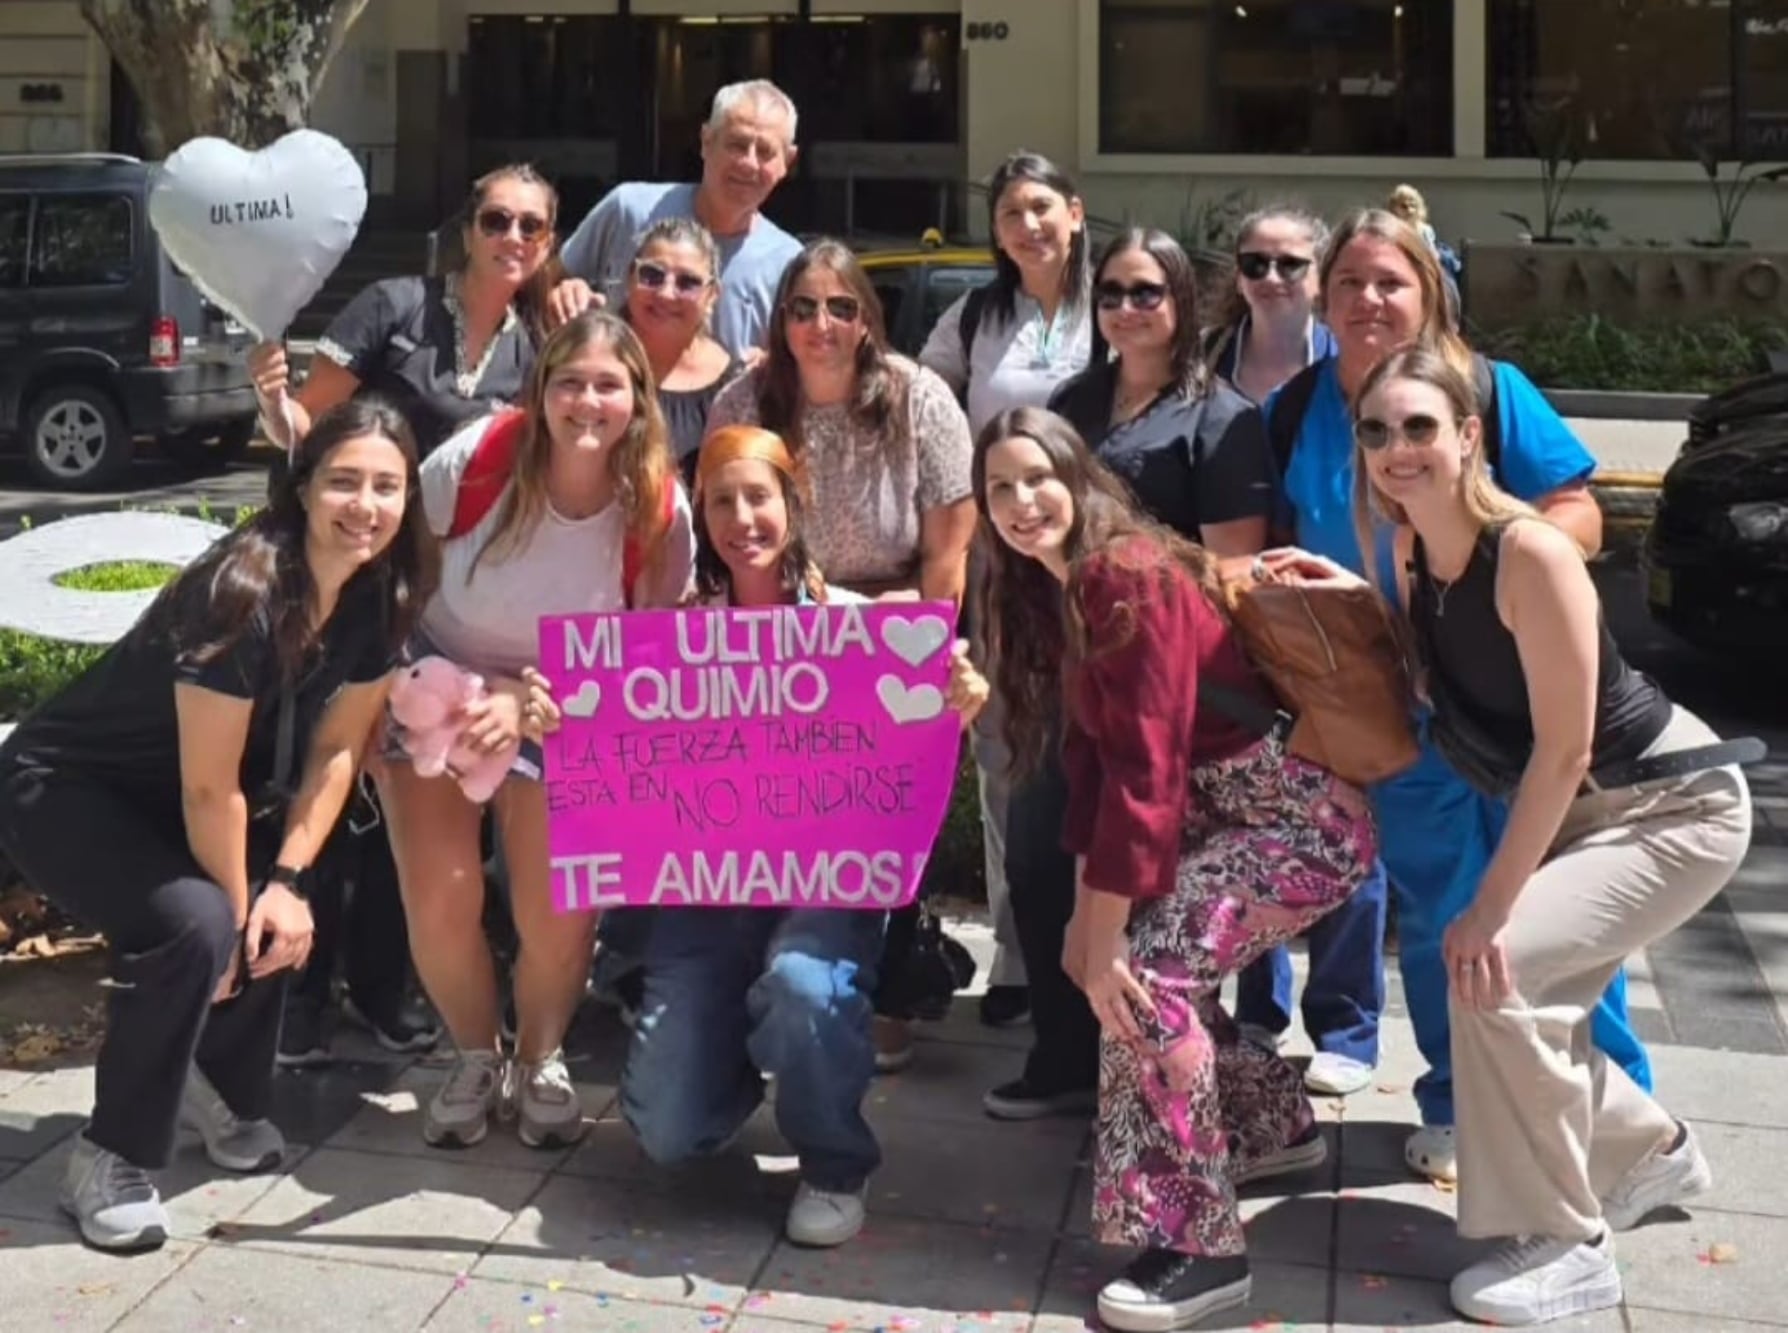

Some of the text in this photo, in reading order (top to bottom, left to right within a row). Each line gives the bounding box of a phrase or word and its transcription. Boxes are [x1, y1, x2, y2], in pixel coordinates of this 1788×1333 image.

[210, 191, 294, 225] ULTIMA!
[563, 602, 877, 671] MI ULTIMA
[622, 661, 830, 721] QUIMIO
[559, 717, 878, 777] LA FUERZA TAMBIEN
[546, 762, 918, 833] ESTA EN NO RENDIRSE
[551, 851, 626, 912] TE
